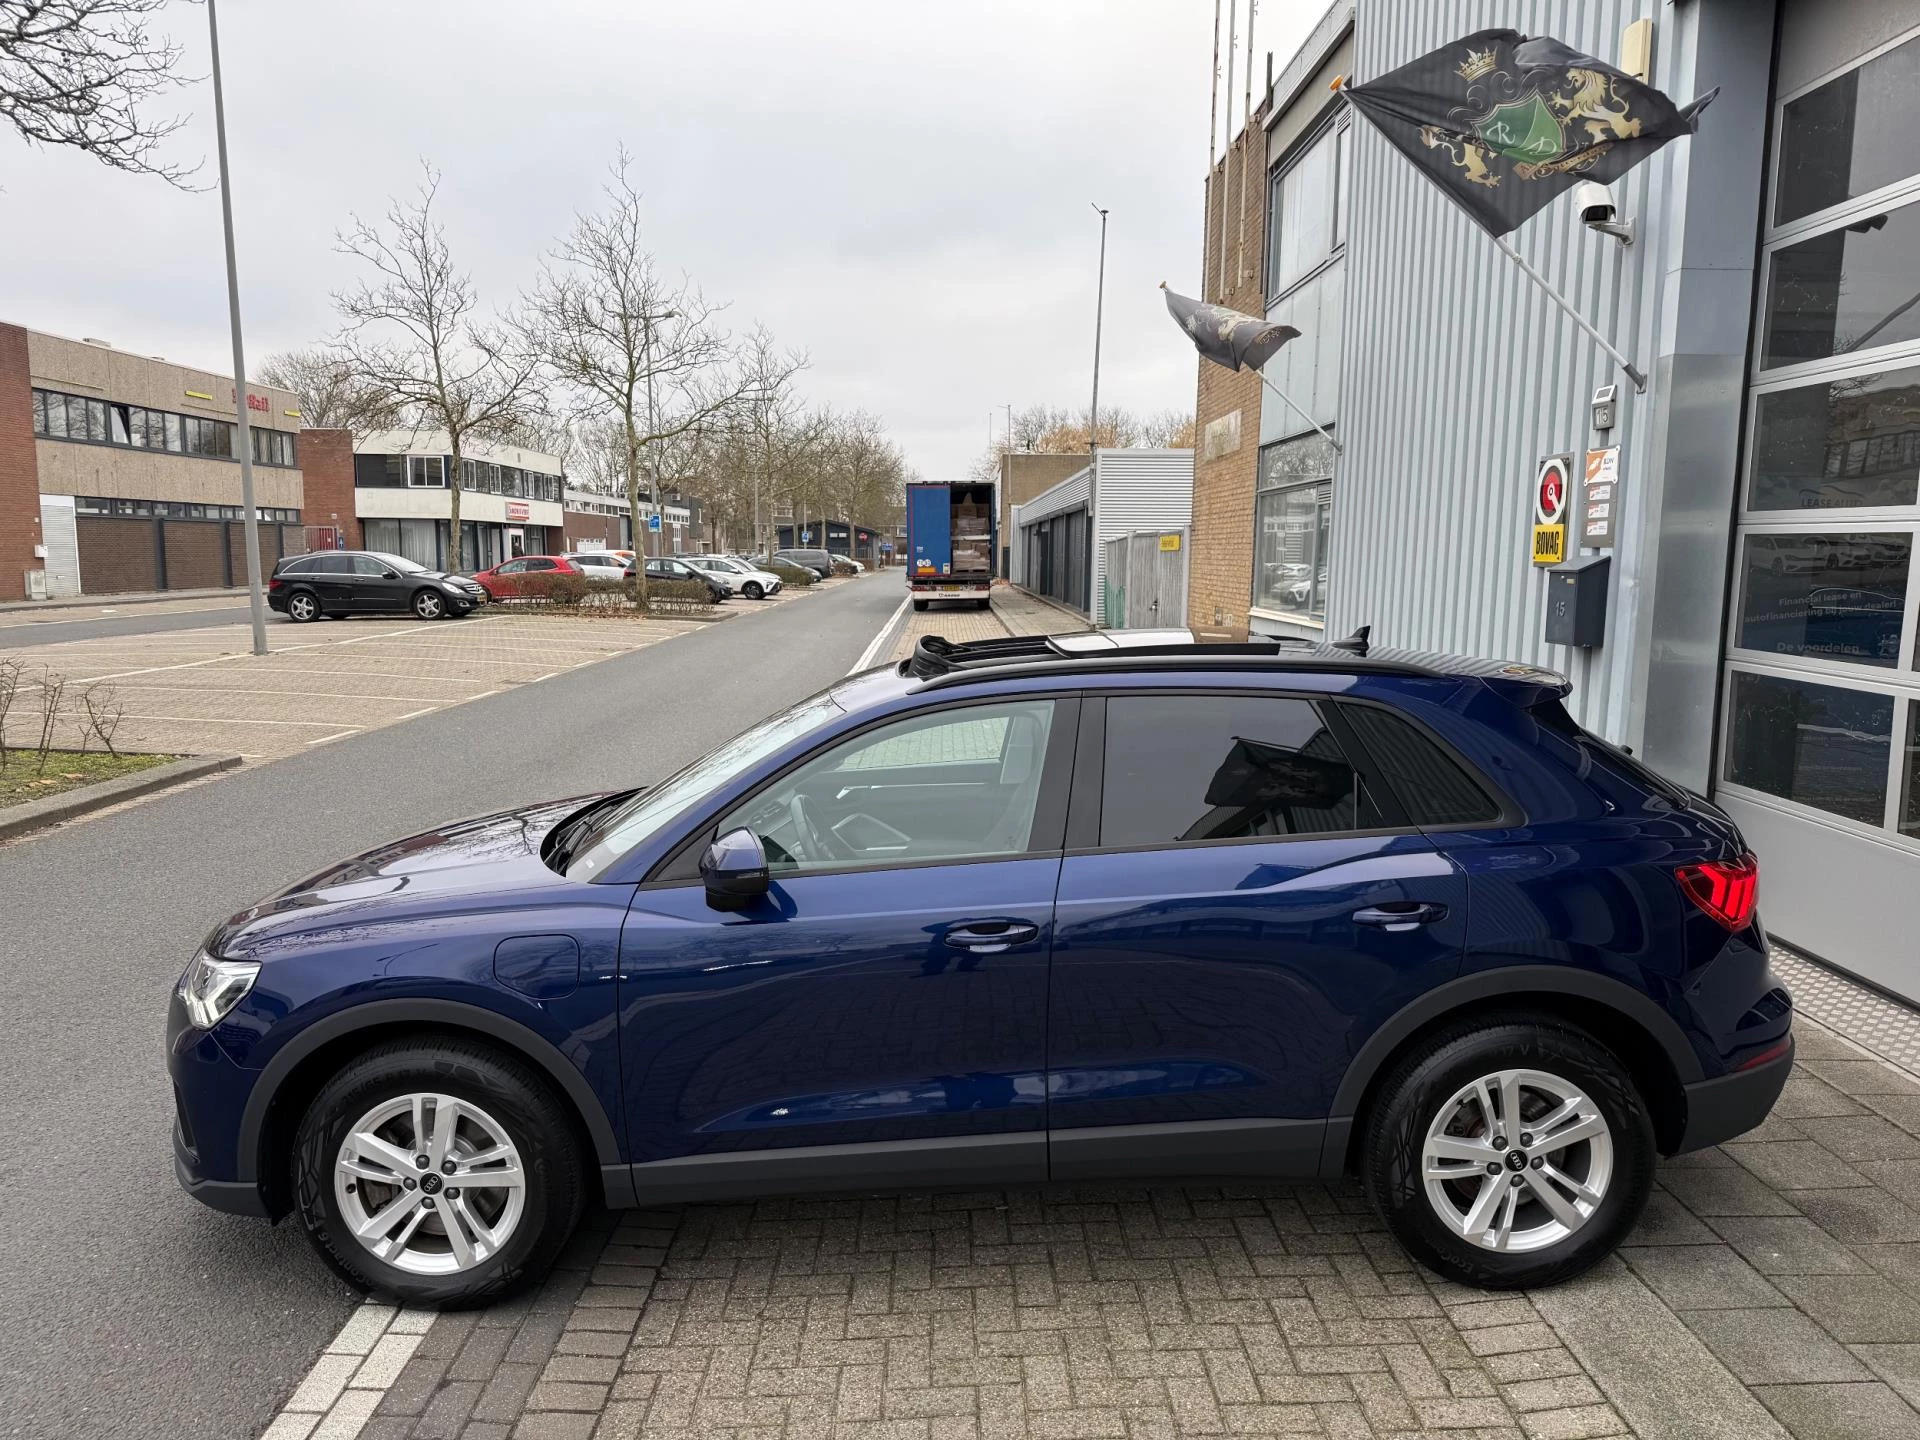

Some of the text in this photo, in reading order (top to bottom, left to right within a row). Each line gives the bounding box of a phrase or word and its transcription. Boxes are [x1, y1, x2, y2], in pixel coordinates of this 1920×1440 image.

[1487, 121, 1517, 145] R
[1595, 406, 1609, 424] 15
[1801, 496, 1832, 508] LEASE
[1535, 529, 1560, 556] BOVAG
[1778, 591, 1862, 607] Financial lease en
[1555, 601, 1566, 618] 15
[1744, 608, 1823, 624] autofinanciering
[1777, 642, 1860, 654] De voordelen
